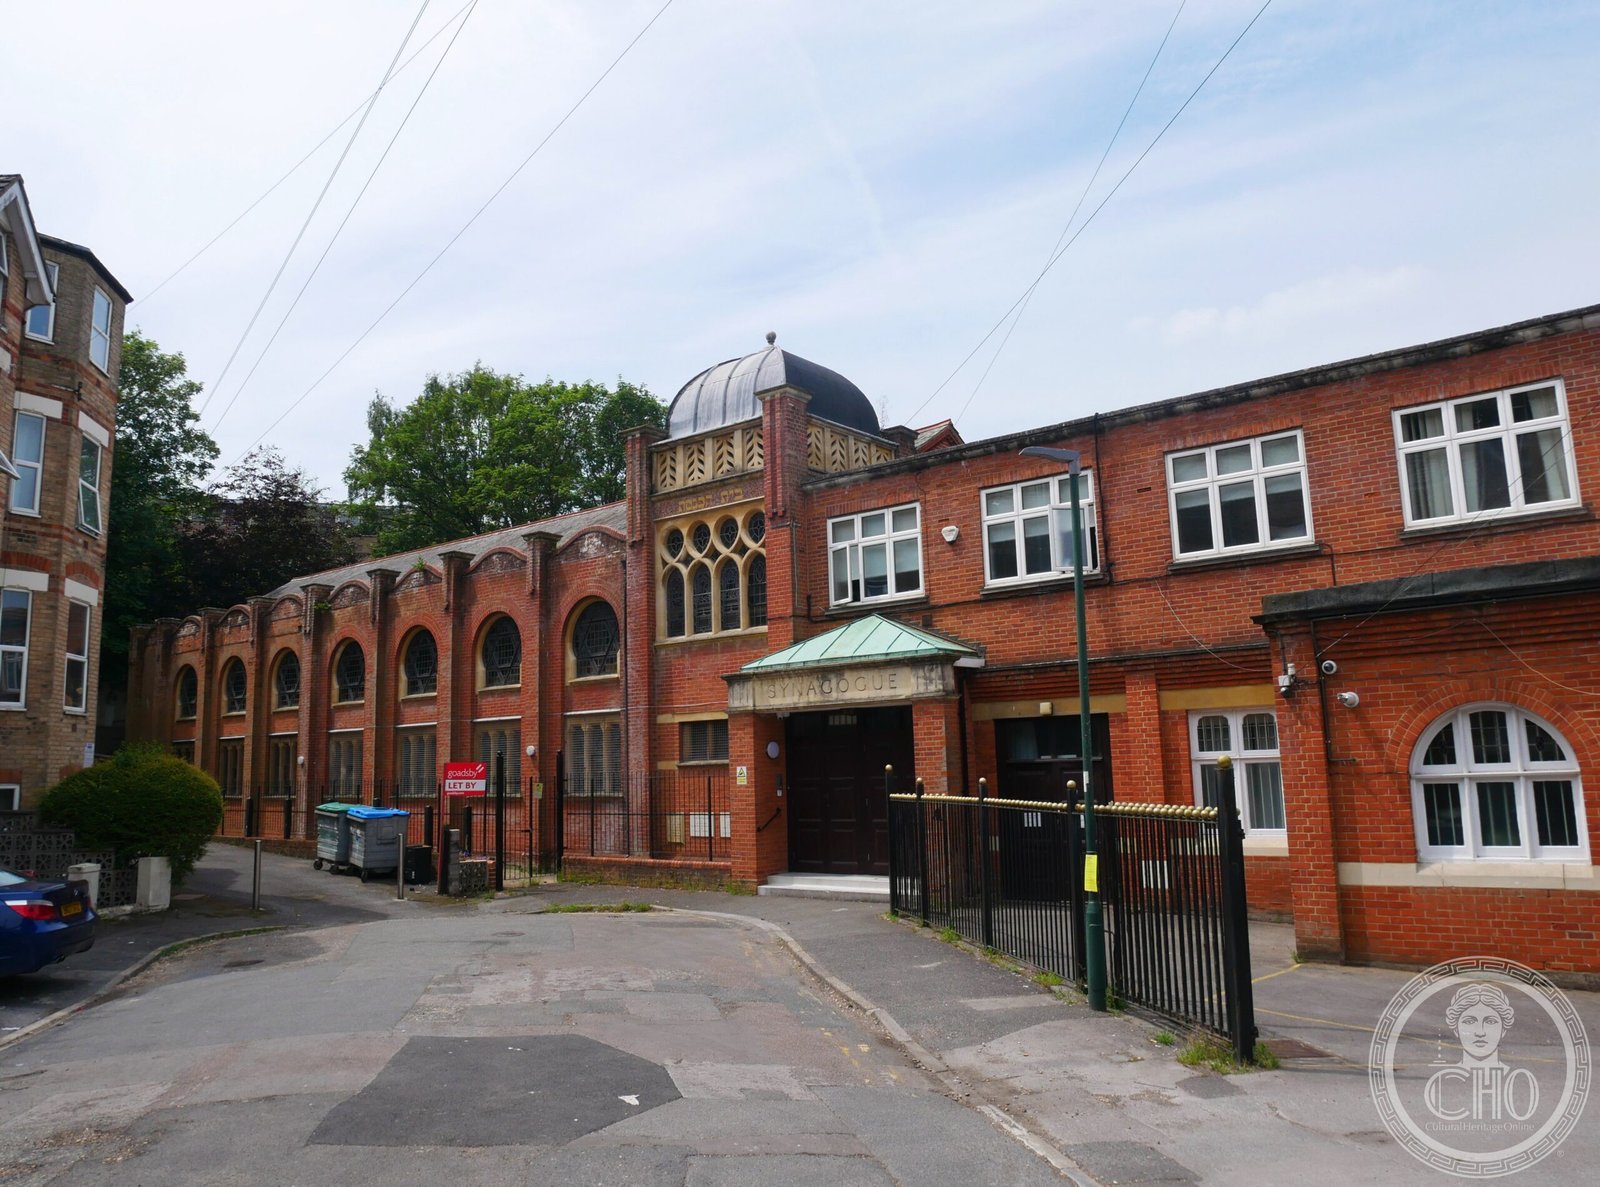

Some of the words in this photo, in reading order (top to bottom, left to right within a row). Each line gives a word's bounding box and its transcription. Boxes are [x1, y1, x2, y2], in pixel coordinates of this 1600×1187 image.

[767, 673, 897, 699] SYNAGOGUE
[447, 768, 478, 779] goadsby
[448, 781, 463, 790] LET
[465, 781, 477, 789] BY
